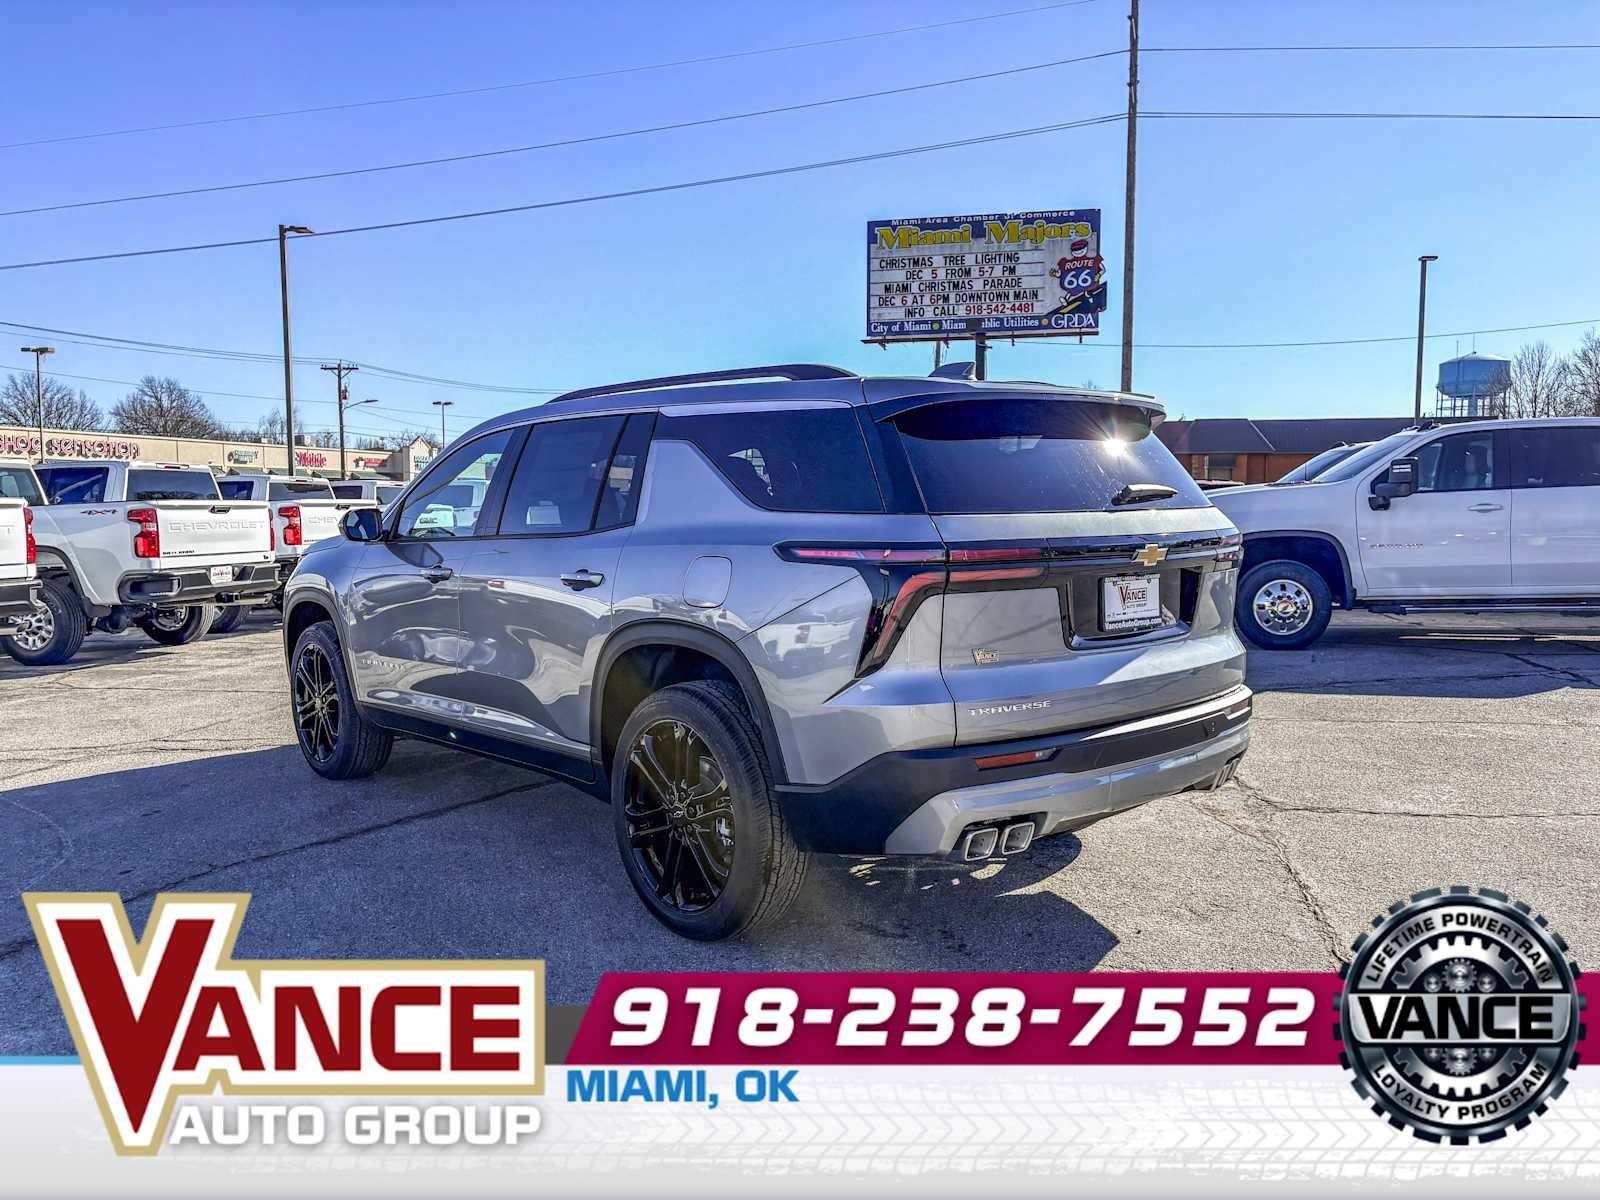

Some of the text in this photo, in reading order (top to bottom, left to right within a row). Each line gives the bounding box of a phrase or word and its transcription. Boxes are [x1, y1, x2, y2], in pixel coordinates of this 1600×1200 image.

[953, 214, 999, 222] Chamber
[1019, 210, 1076, 219] Commerce
[875, 220, 1092, 250] Miami Majors
[879, 253, 1020, 269] CHRISTMAS TREE LIGHTING
[1064, 259, 1095, 272] ROUTE
[905, 265, 1016, 280] DEC 5 FROM 5-7 PM
[1063, 269, 1092, 289] 66
[884, 277, 1023, 294] MIAMI CHRISTMAS PARADE
[878, 289, 1039, 307] DEC 6 AT 6PM DOWNTOWN MAIN
[904, 302, 1034, 318] INFO CALL 918-542-4481
[871, 318, 931, 335] City of Miami
[942, 319, 967, 330] Miam
[1003, 315, 1039, 328] Utilities
[1051, 312, 1096, 329] GRDA
[168, 521, 266, 535] CHEVROLET
[1120, 585, 1147, 606] VANCE
[968, 700, 1052, 716] TRAVERSE
